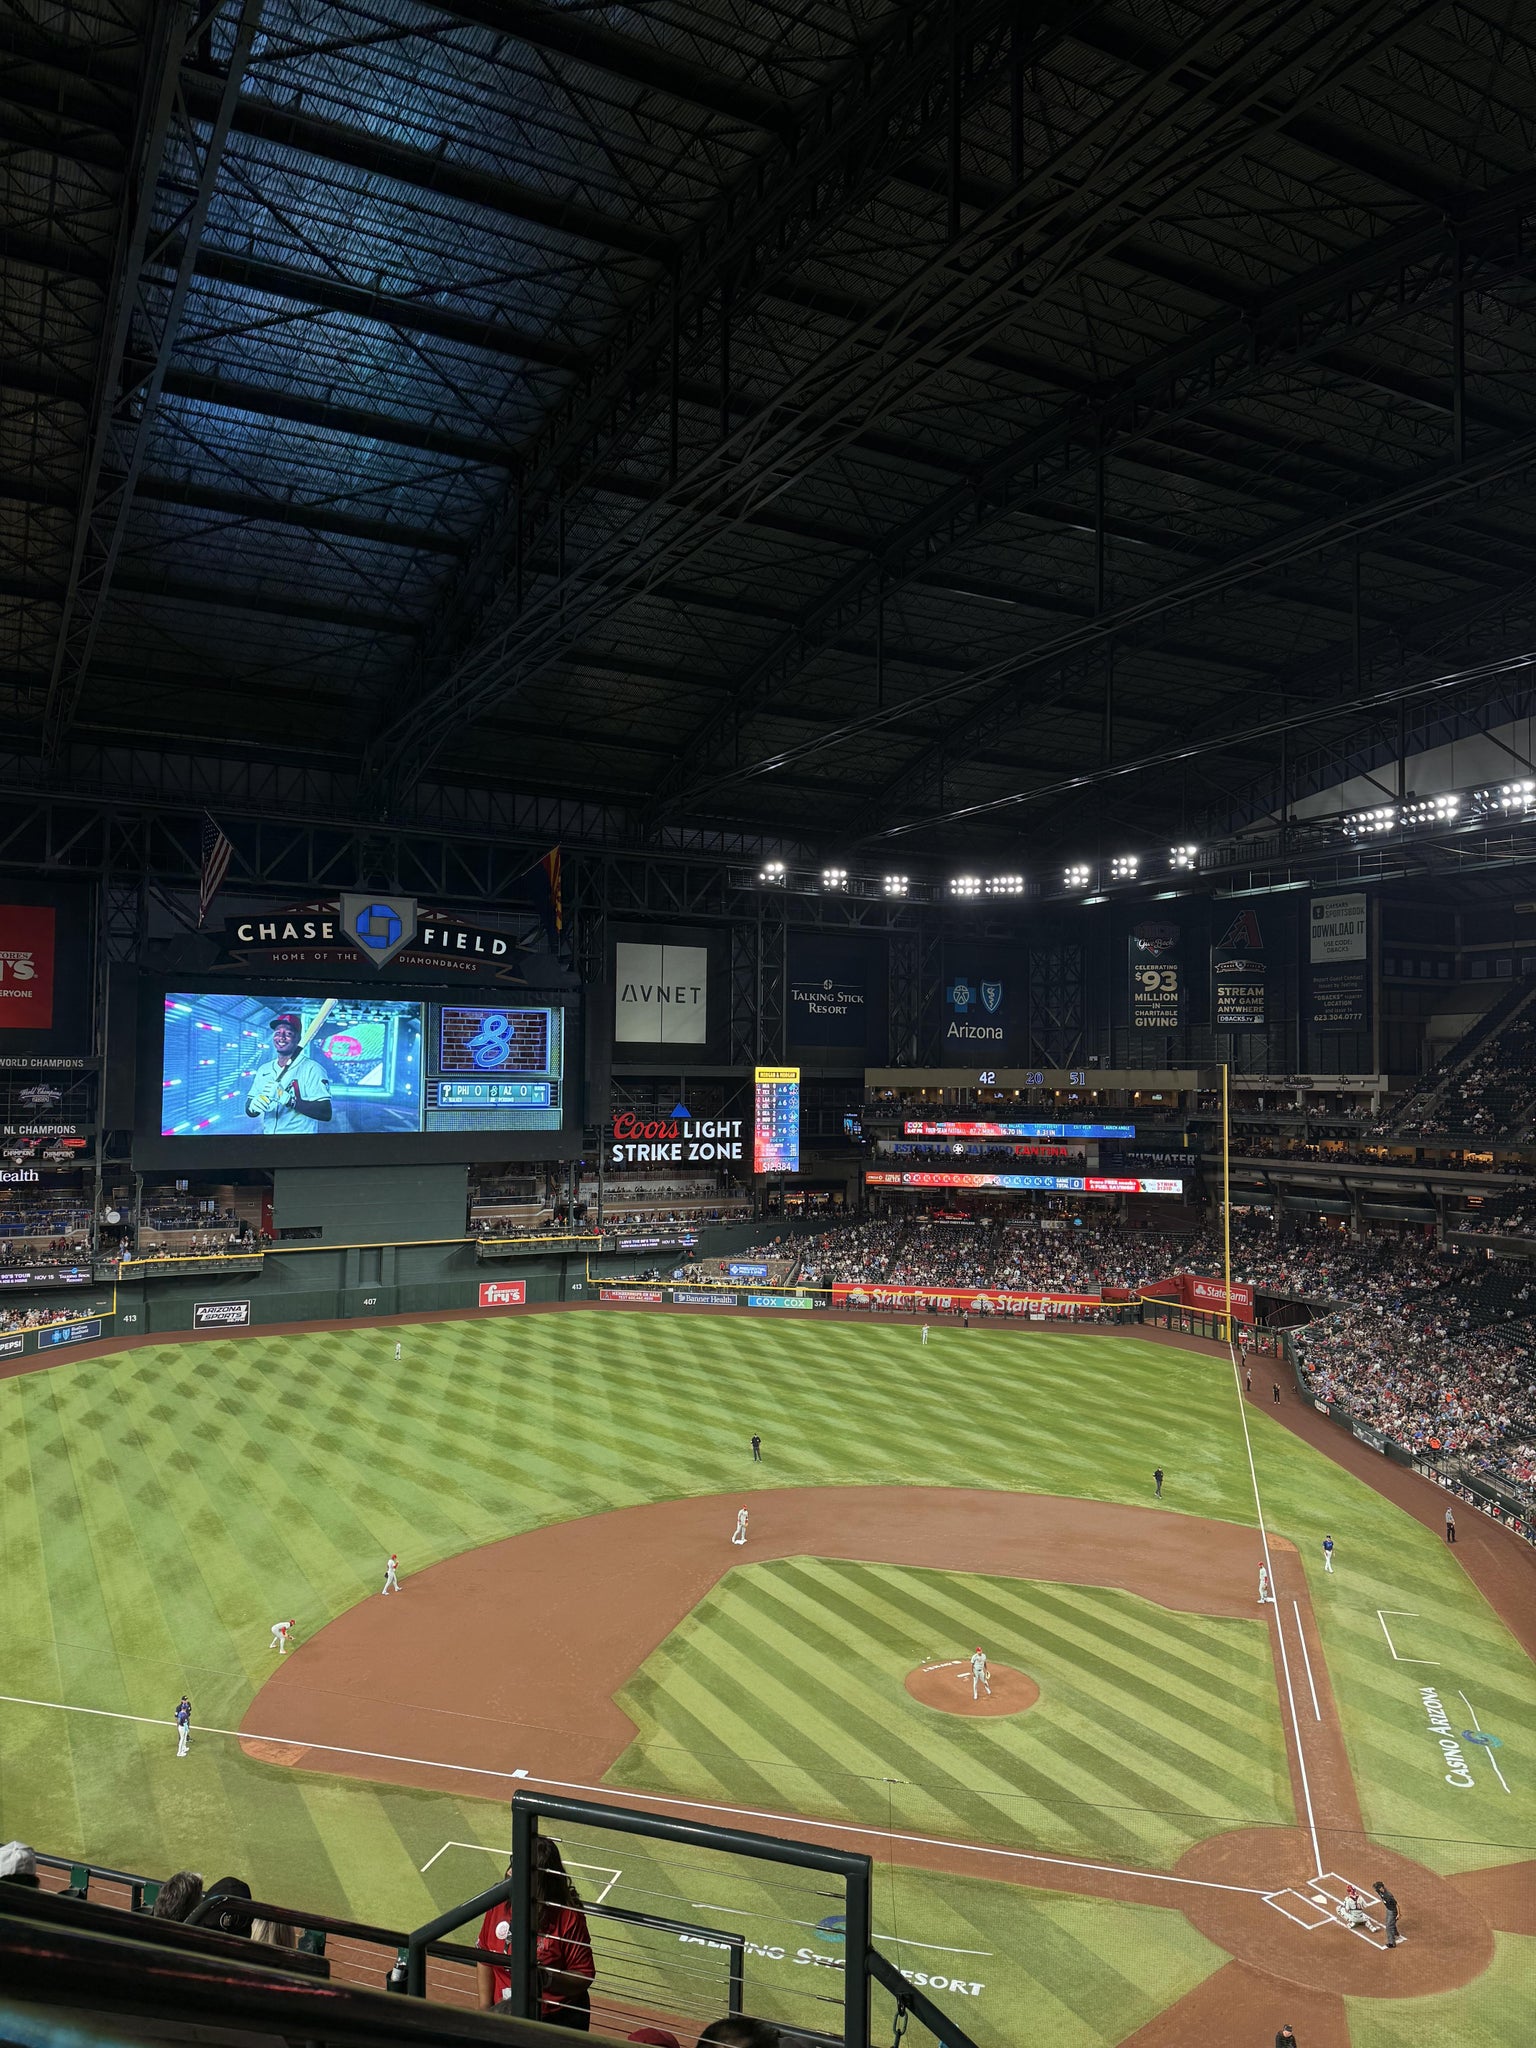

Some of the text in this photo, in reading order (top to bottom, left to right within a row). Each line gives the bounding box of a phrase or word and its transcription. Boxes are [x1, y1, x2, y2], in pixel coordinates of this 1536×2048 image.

[1312, 920, 1364, 938] DOWNLOAD IT
[237, 923, 507, 955] CHASE FIELD
[400, 956, 477, 971] DIAMONDBACKS
[1135, 971, 1178, 991] $93
[622, 984, 701, 1004] AVNET
[792, 990, 864, 1004] TALKING STICK
[1218, 987, 1264, 996] STREAM
[809, 1003, 847, 1015] RESORT
[1135, 1018, 1178, 1026] GIVING
[947, 1022, 1003, 1039] Arizona
[980, 1072, 1086, 1085] 42 20 51
[457, 1086, 469, 1095] PHI
[475, 1086, 481, 1096] 0
[504, 1086, 512, 1095] AZ
[521, 1086, 527, 1096] 0
[4, 1126, 76, 1134] NL CHAMPIONS
[613, 1112, 742, 1139] Coors LIGHT
[612, 1143, 742, 1162] STRIKE ZONE
[484, 1285, 520, 1302] fry's
[686, 1294, 732, 1304] Banner Health
[756, 1298, 804, 1307] COX COX
[0, 1341, 21, 1350] PEPSI
[1418, 1687, 1475, 1788] CASINO ARIZONA
[900, 1970, 985, 1996] ESORT
